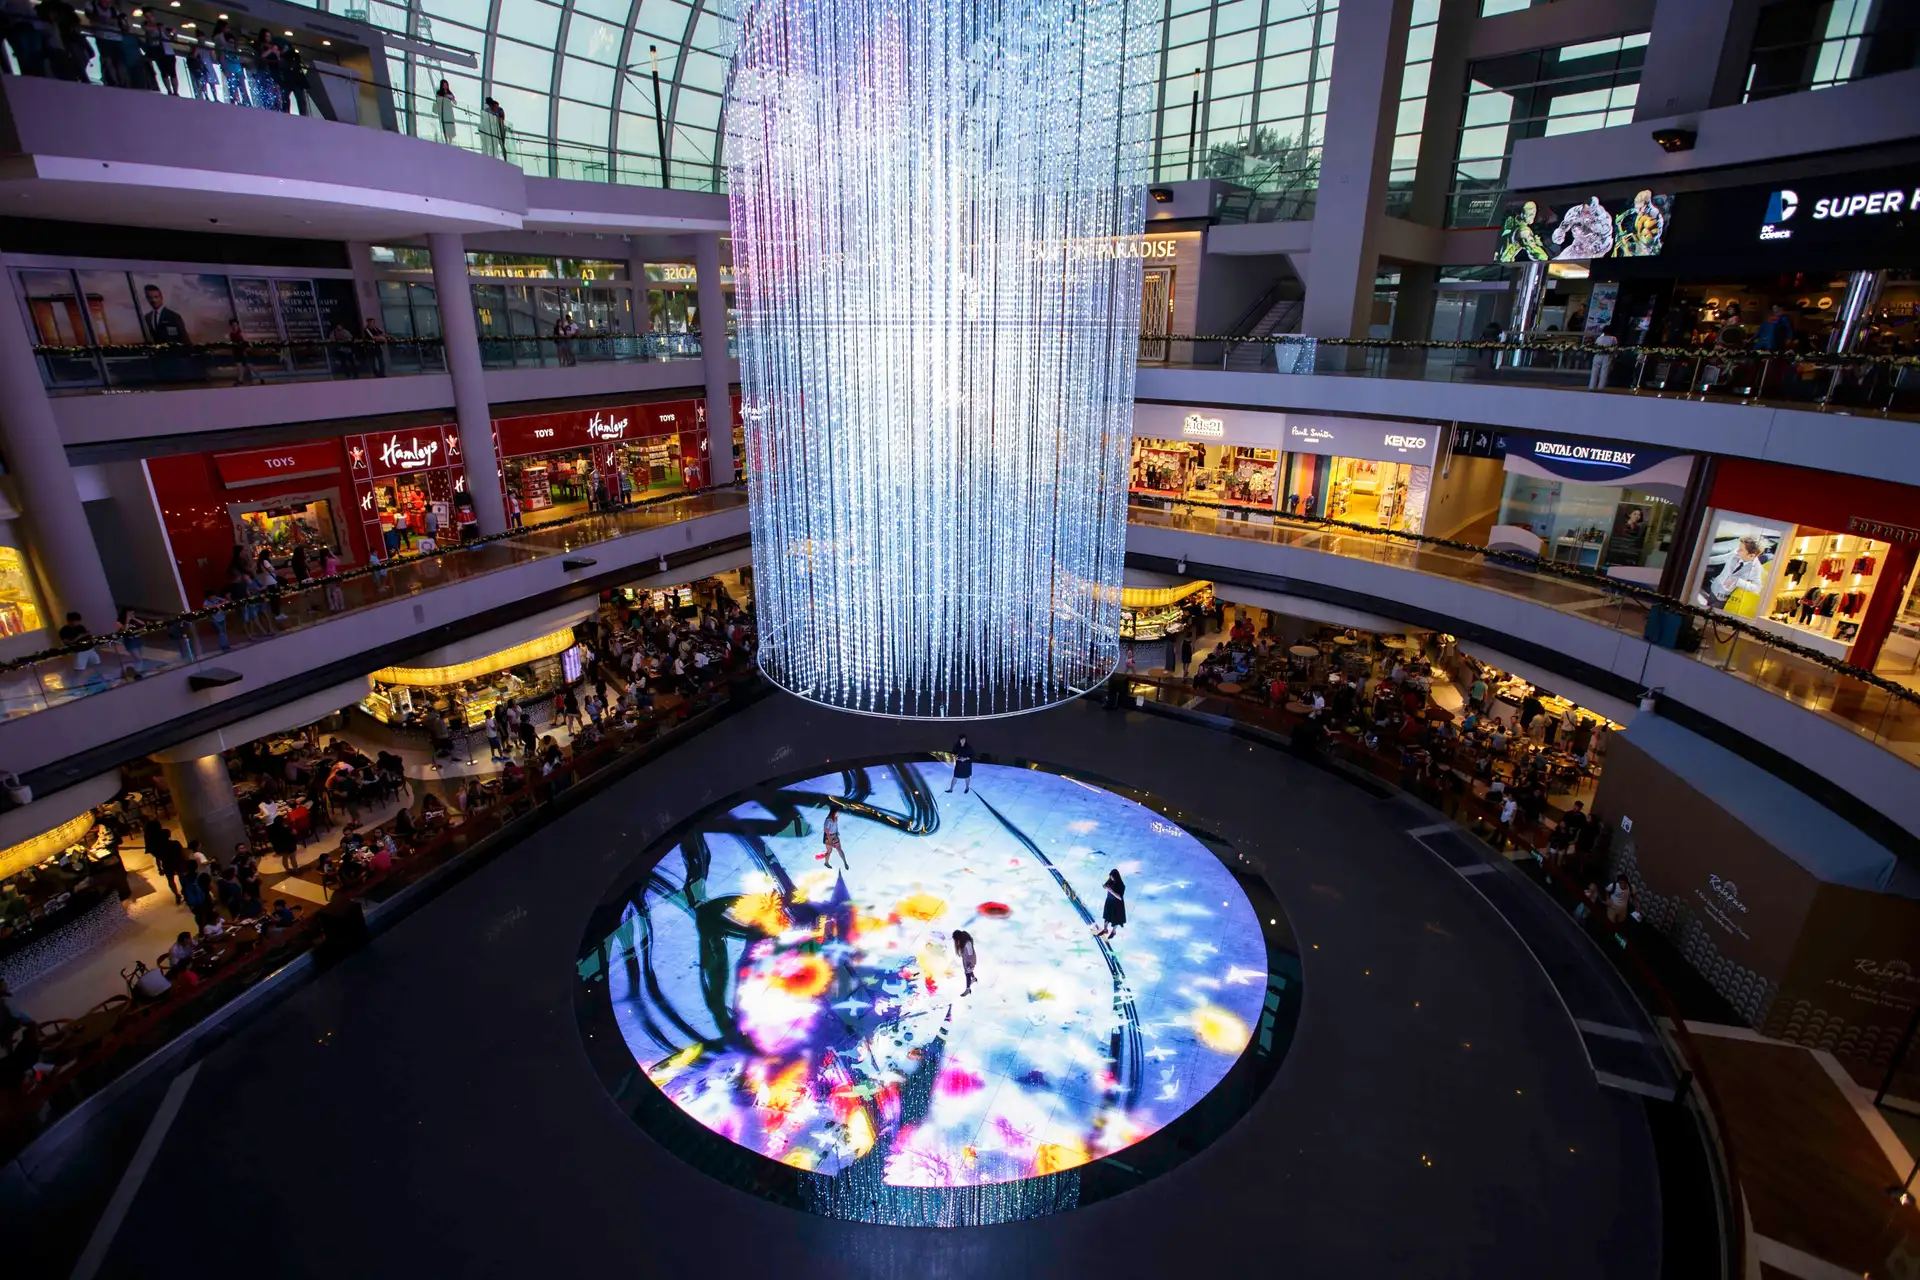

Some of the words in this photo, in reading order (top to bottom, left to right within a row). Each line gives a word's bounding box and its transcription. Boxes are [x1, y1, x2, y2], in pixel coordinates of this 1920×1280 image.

[1812, 190, 1904, 219] SUPER
[1759, 230, 1791, 240] COMICS
[1761, 224, 1775, 233] DC
[1097, 240, 1177, 260] PARADISE
[660, 413, 675, 423] TOYS
[586, 412, 628, 439] Hamleys
[1292, 426, 1309, 437] Paul
[1310, 428, 1334, 439] Smith
[534, 428, 554, 438] TOYS
[1384, 434, 1426, 449] KENZO
[379, 434, 438, 468] Hamleys
[1534, 441, 1572, 458] DENTAL
[1573, 446, 1590, 459] ON
[1590, 449, 1612, 461] THE
[1613, 452, 1635, 465] BAY
[264, 456, 296, 468] TOYS
